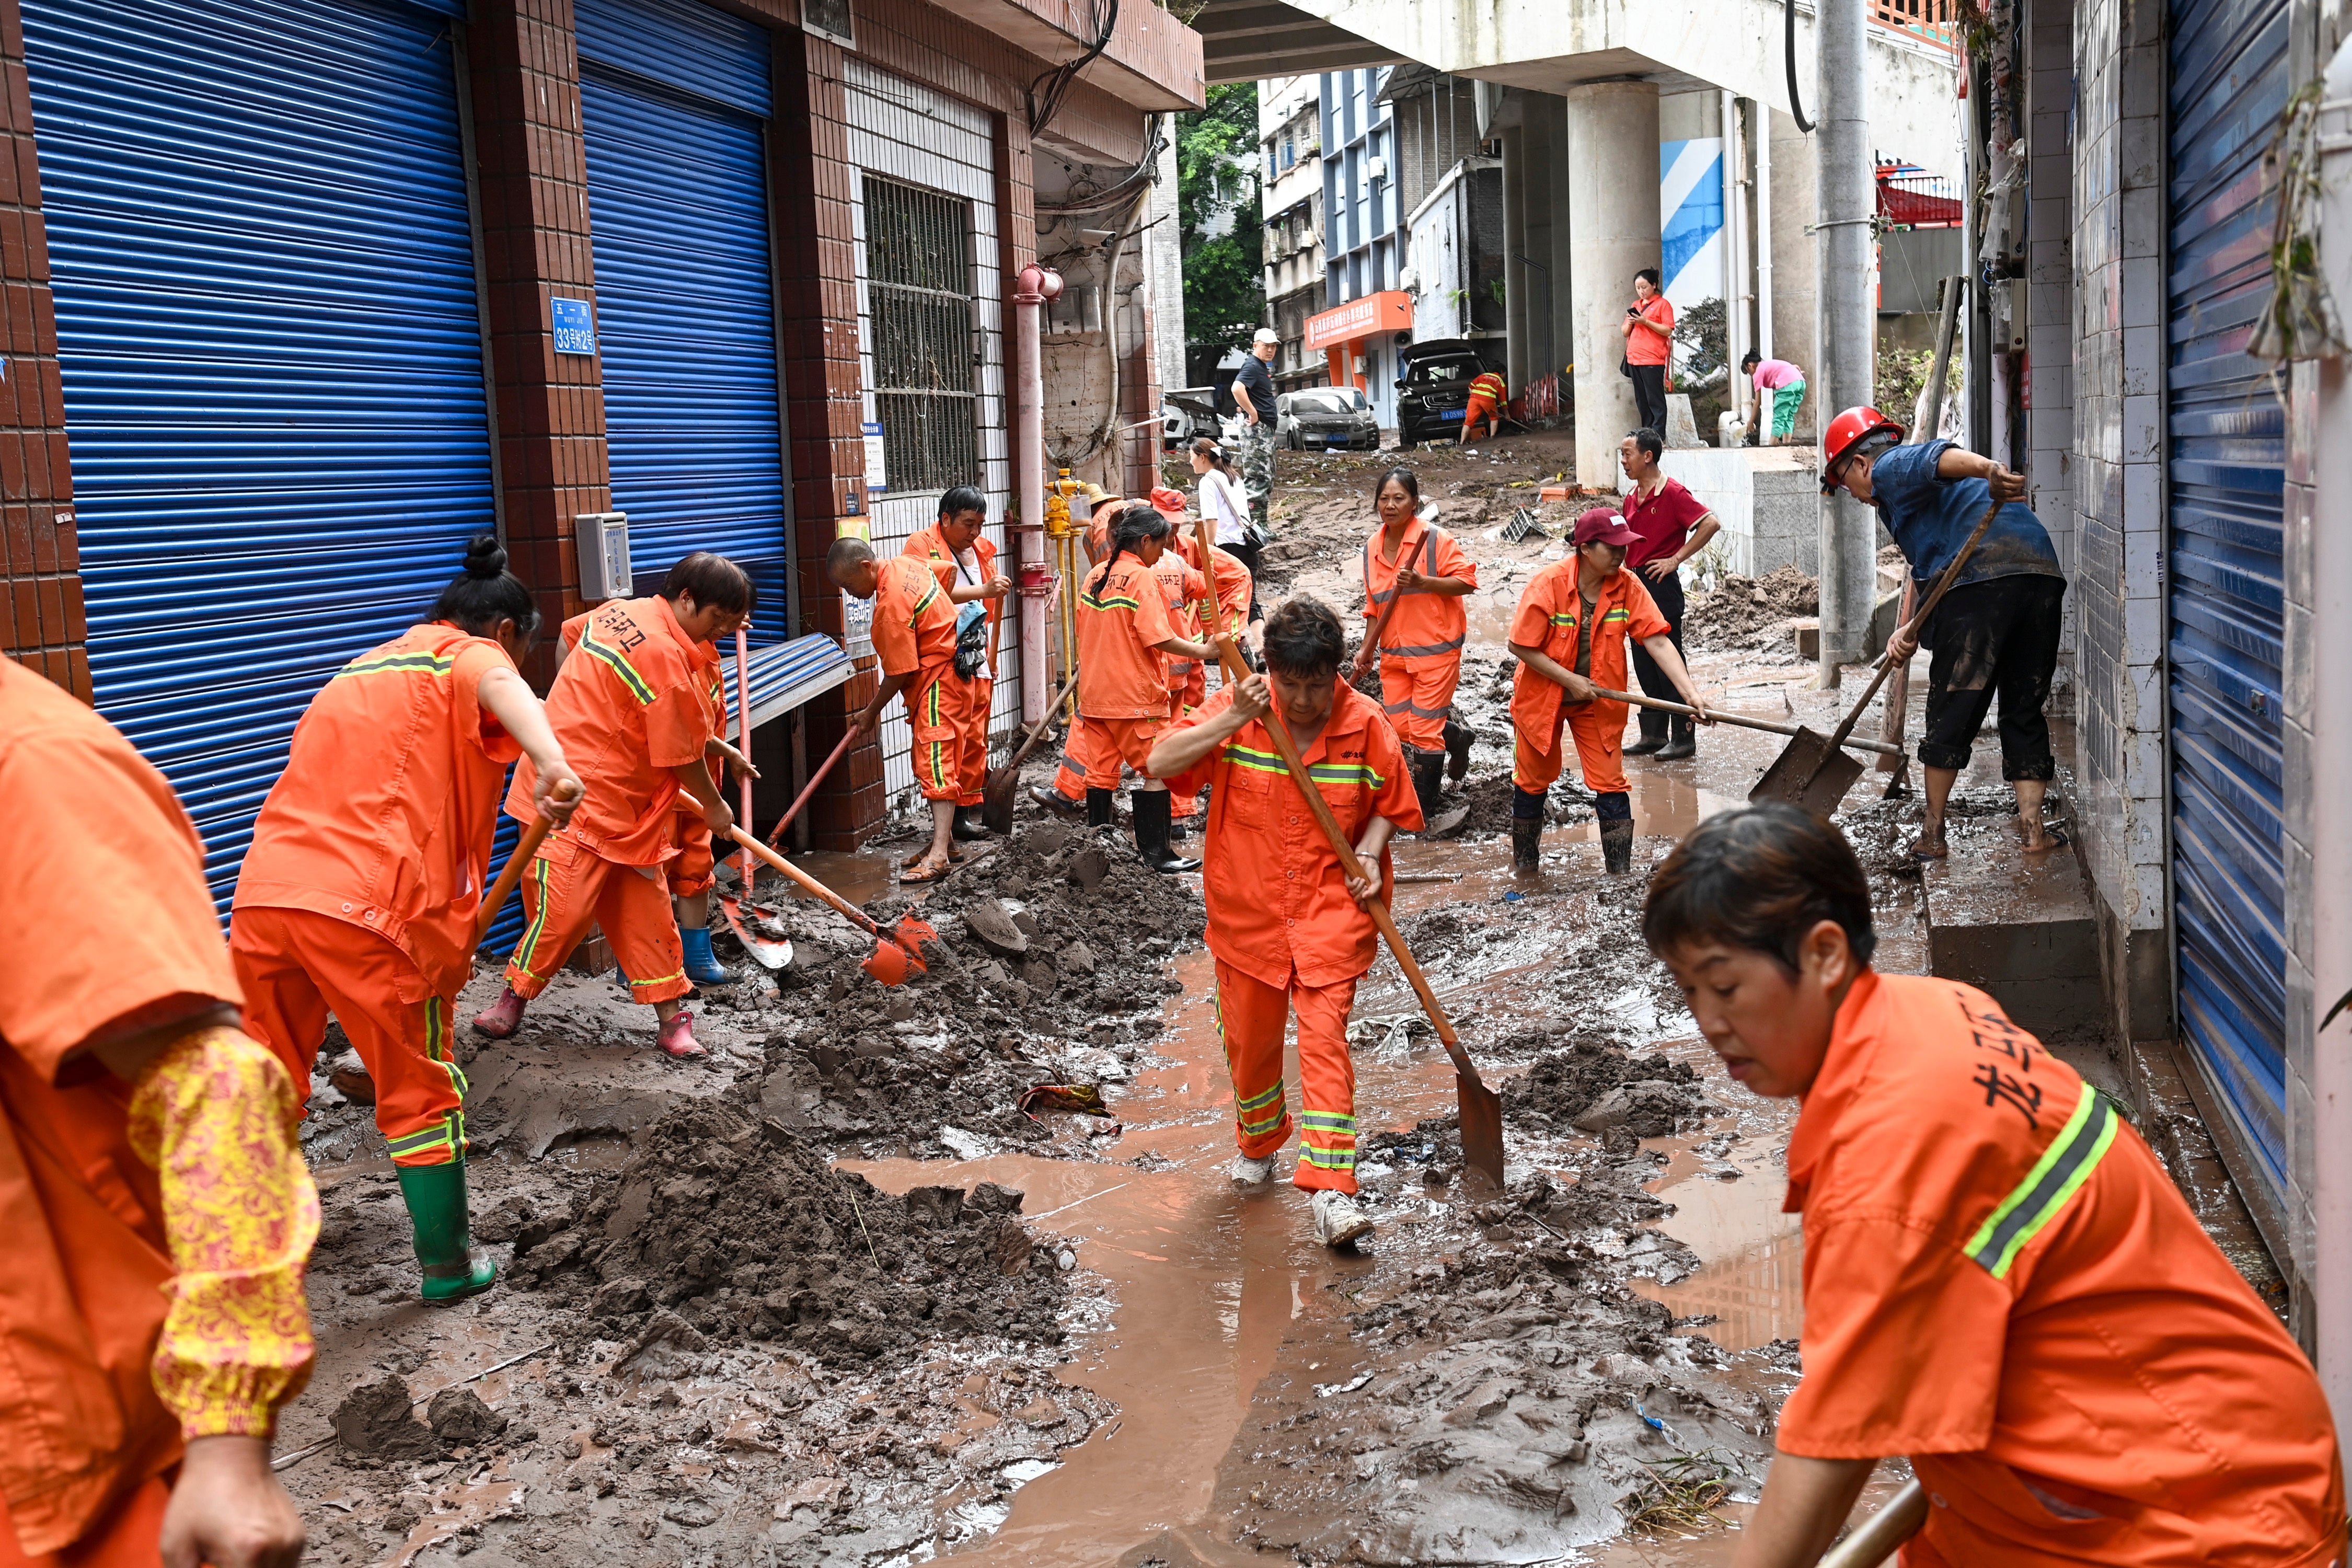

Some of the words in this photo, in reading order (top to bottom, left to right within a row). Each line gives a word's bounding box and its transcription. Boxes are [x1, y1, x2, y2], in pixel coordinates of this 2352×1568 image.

[556, 303, 587, 317] 五一街
[557, 327, 593, 351] 33号附2号
[1088, 573, 1130, 592] 龙环卫
